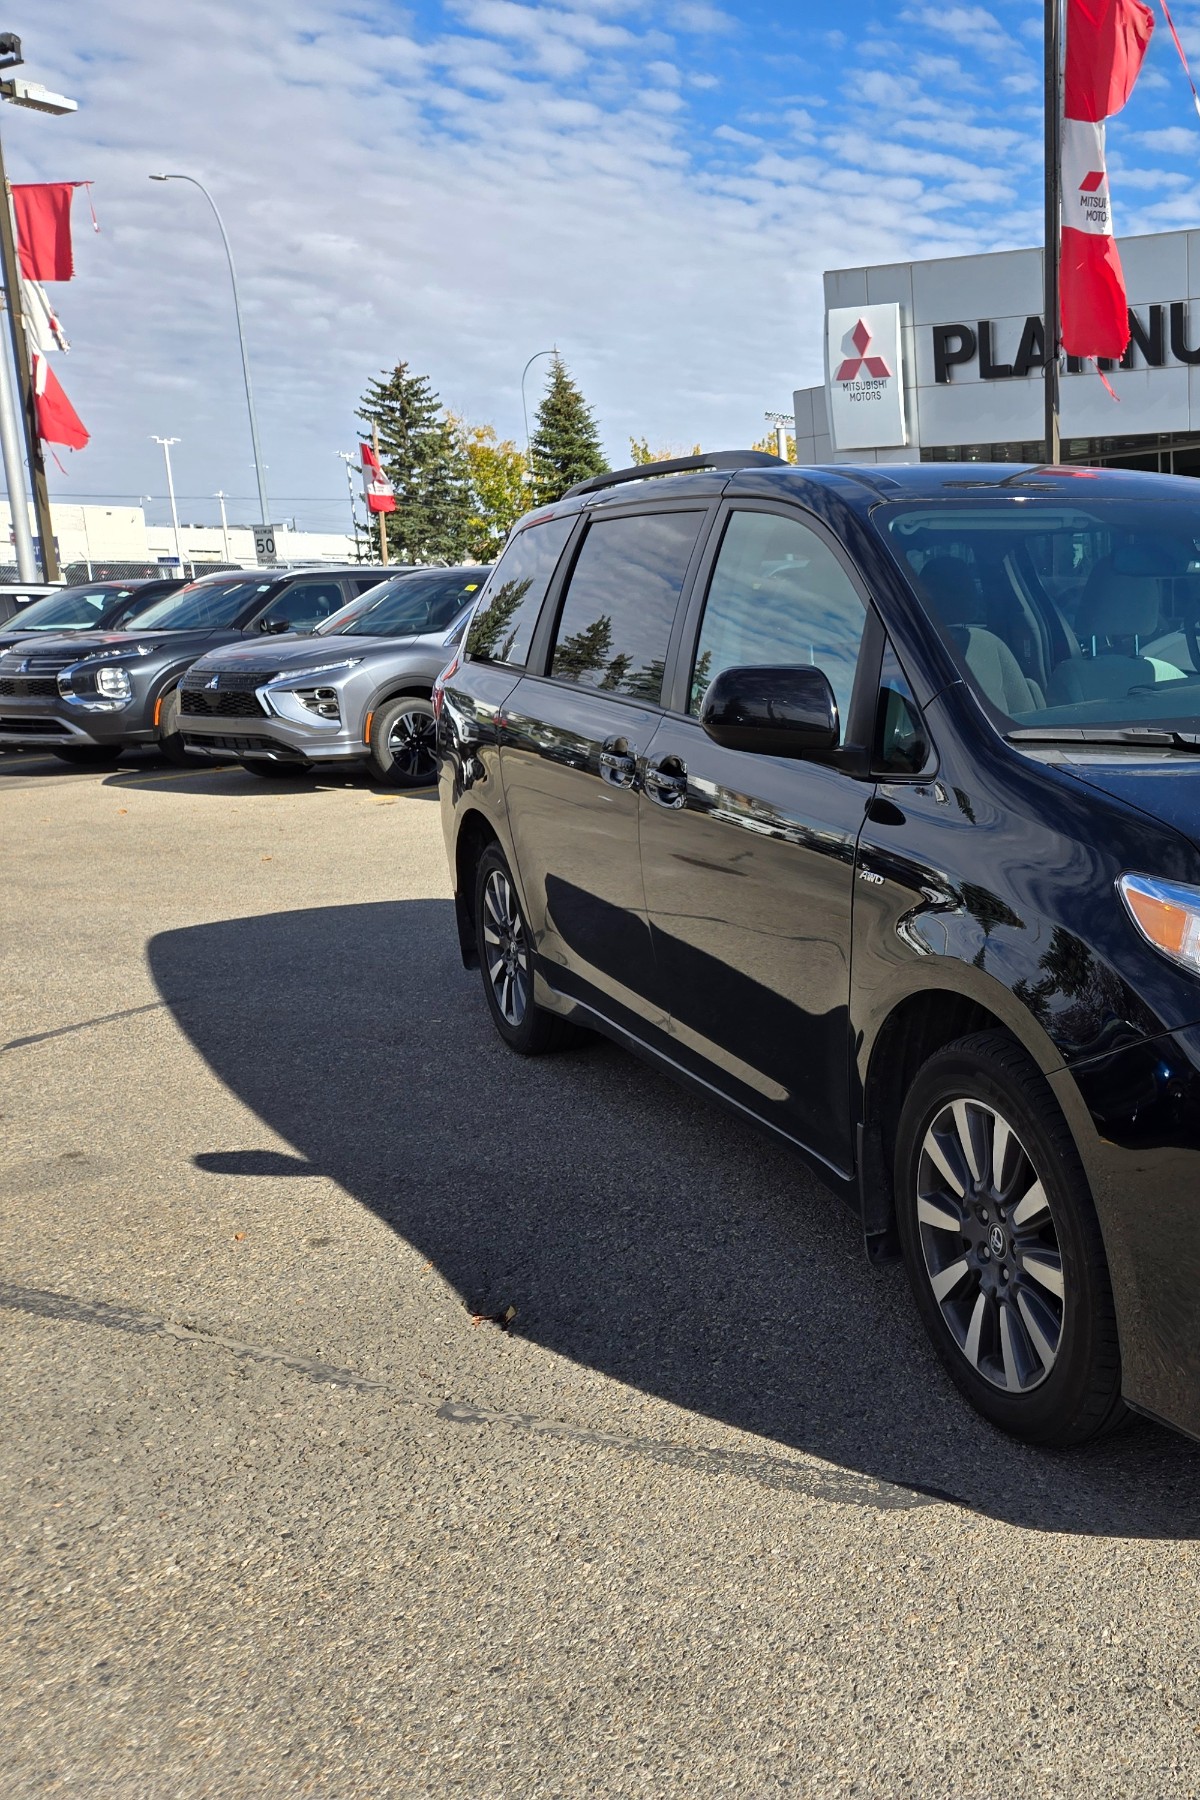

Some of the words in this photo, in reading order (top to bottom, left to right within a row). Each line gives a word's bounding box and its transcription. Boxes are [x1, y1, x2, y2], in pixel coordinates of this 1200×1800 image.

[1086, 209, 1107, 222] MOTO
[842, 380, 888, 392] MITSUBISHI
[849, 391, 882, 402] MOTORS
[256, 538, 275, 553] 50
[859, 870, 885, 885] AWD
